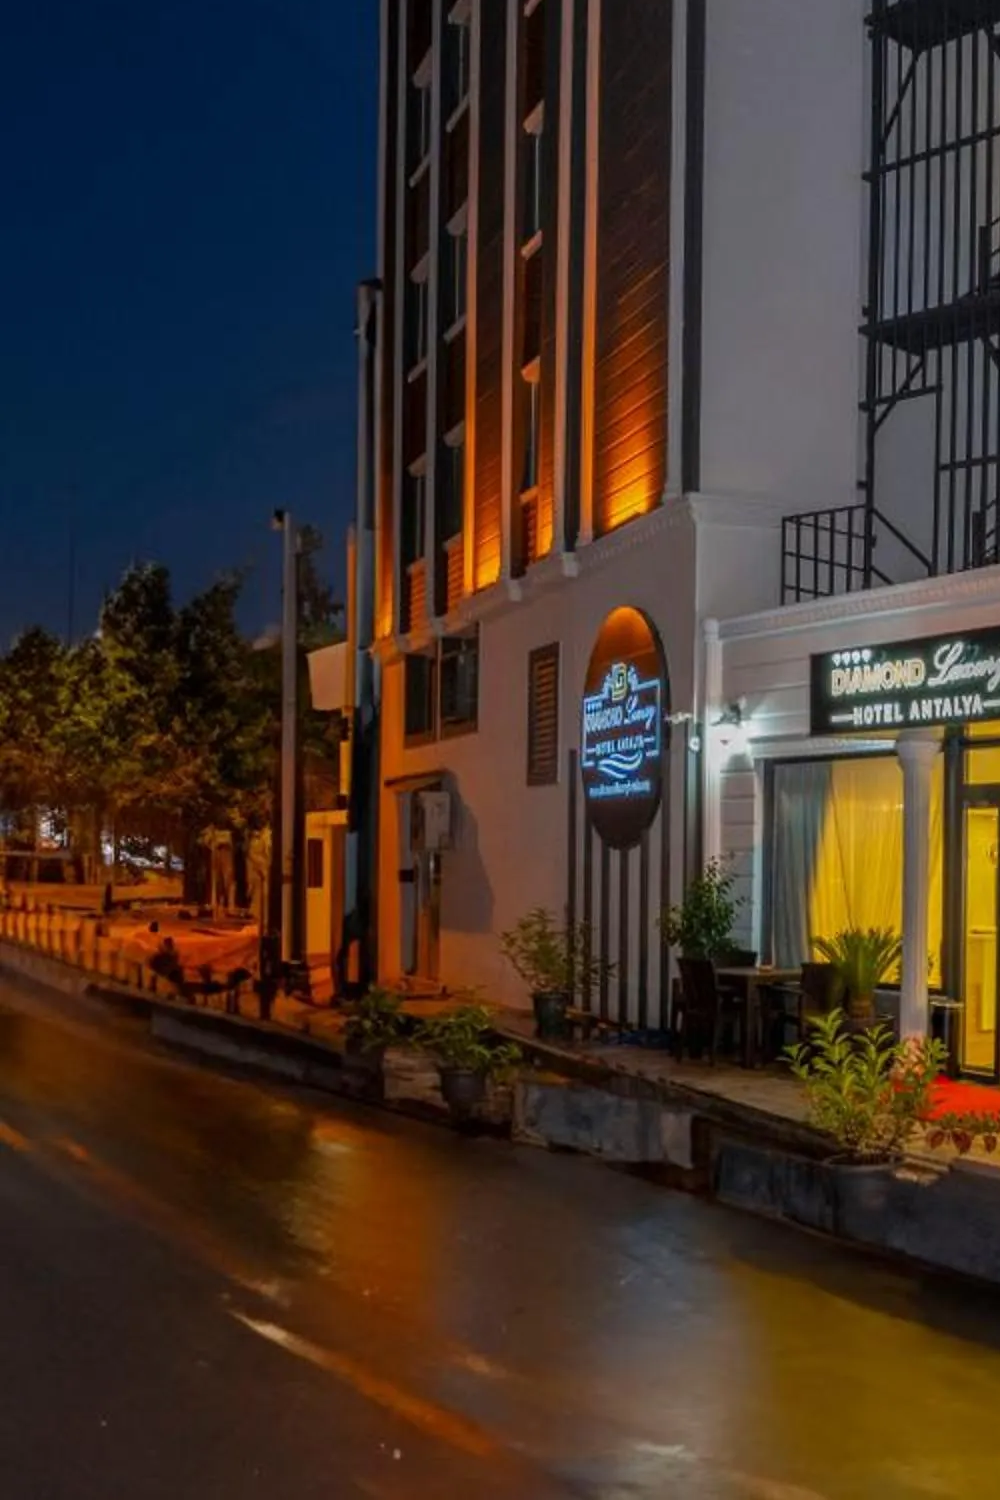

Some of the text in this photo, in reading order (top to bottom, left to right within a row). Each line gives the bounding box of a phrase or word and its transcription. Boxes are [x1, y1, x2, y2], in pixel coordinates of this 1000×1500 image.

[831, 658, 925, 697] DIAMOND
[853, 694, 984, 725] HOTEL ANTALYA
